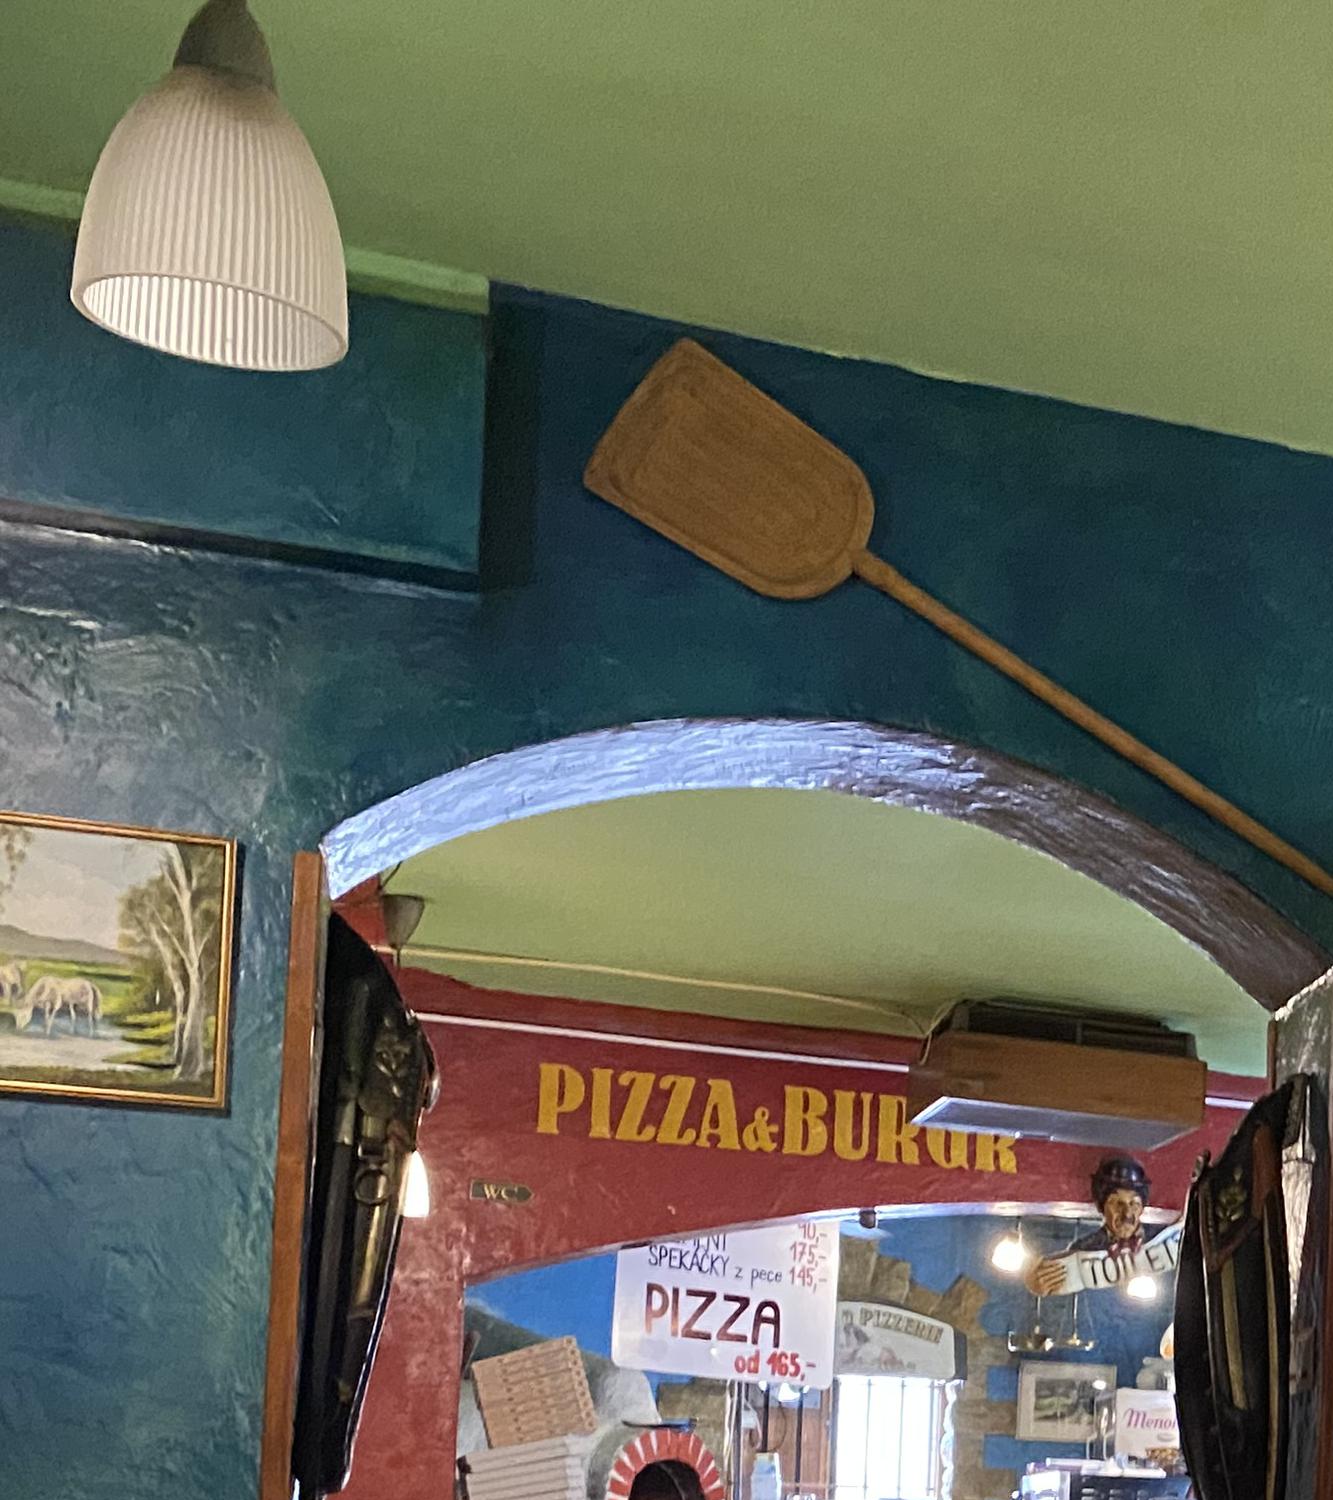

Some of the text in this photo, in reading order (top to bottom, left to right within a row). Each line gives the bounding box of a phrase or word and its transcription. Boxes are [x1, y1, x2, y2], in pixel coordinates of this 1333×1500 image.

[483, 1184, 518, 1201] WC
[735, 1266, 744, 1279] z
[750, 1268, 782, 1289] pece
[644, 1281, 781, 1349] PIZZA
[734, 1349, 817, 1382] od 165,-
